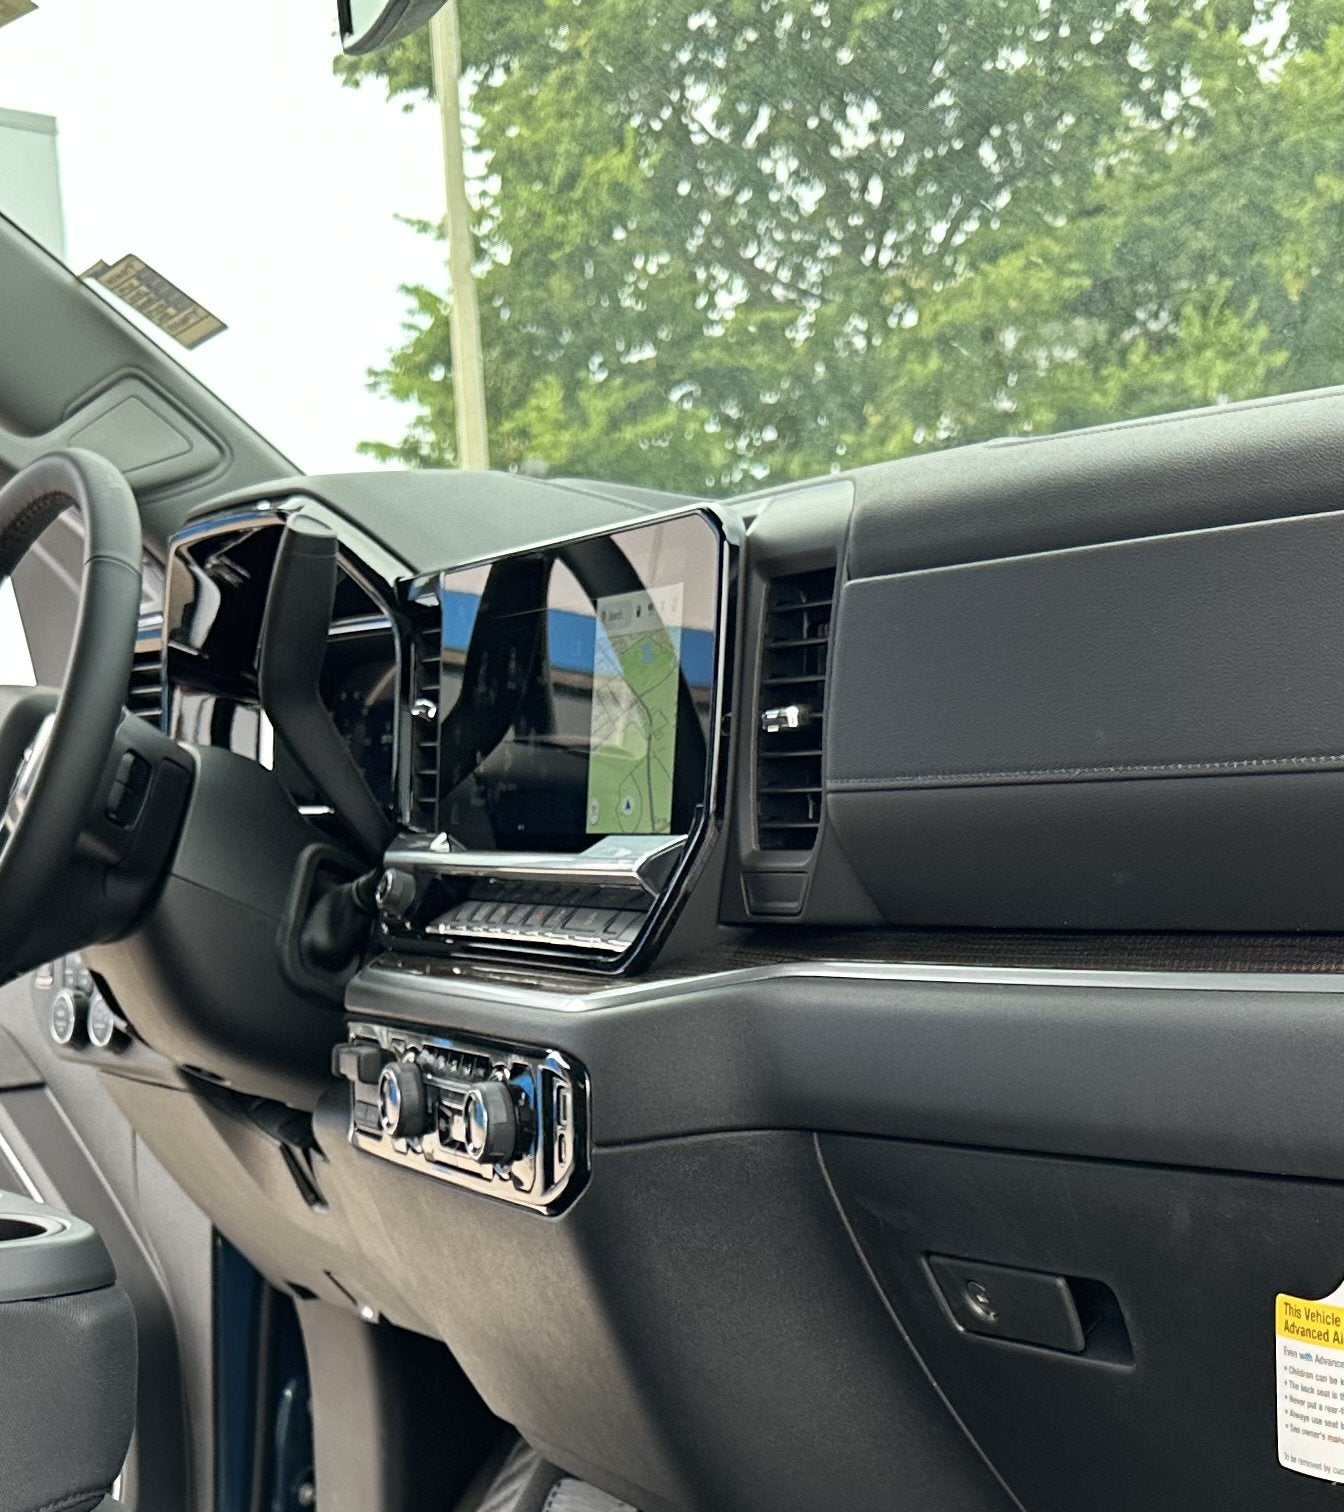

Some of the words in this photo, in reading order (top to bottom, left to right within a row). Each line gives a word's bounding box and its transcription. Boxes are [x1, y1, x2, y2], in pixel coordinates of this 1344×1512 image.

[1284, 1302, 1302, 1318] This
[1305, 1307, 1340, 1327] Vehicle
[1284, 1320, 1329, 1342] Advanced
[1284, 1346, 1297, 1358] Even
[1299, 1352, 1312, 1361] with
[1289, 1366, 1313, 1379] Children
[1316, 1374, 1327, 1382] can
[1330, 1376, 1337, 1384] be
[1289, 1380, 1299, 1390] The
[1332, 1391, 1337, 1399] is
